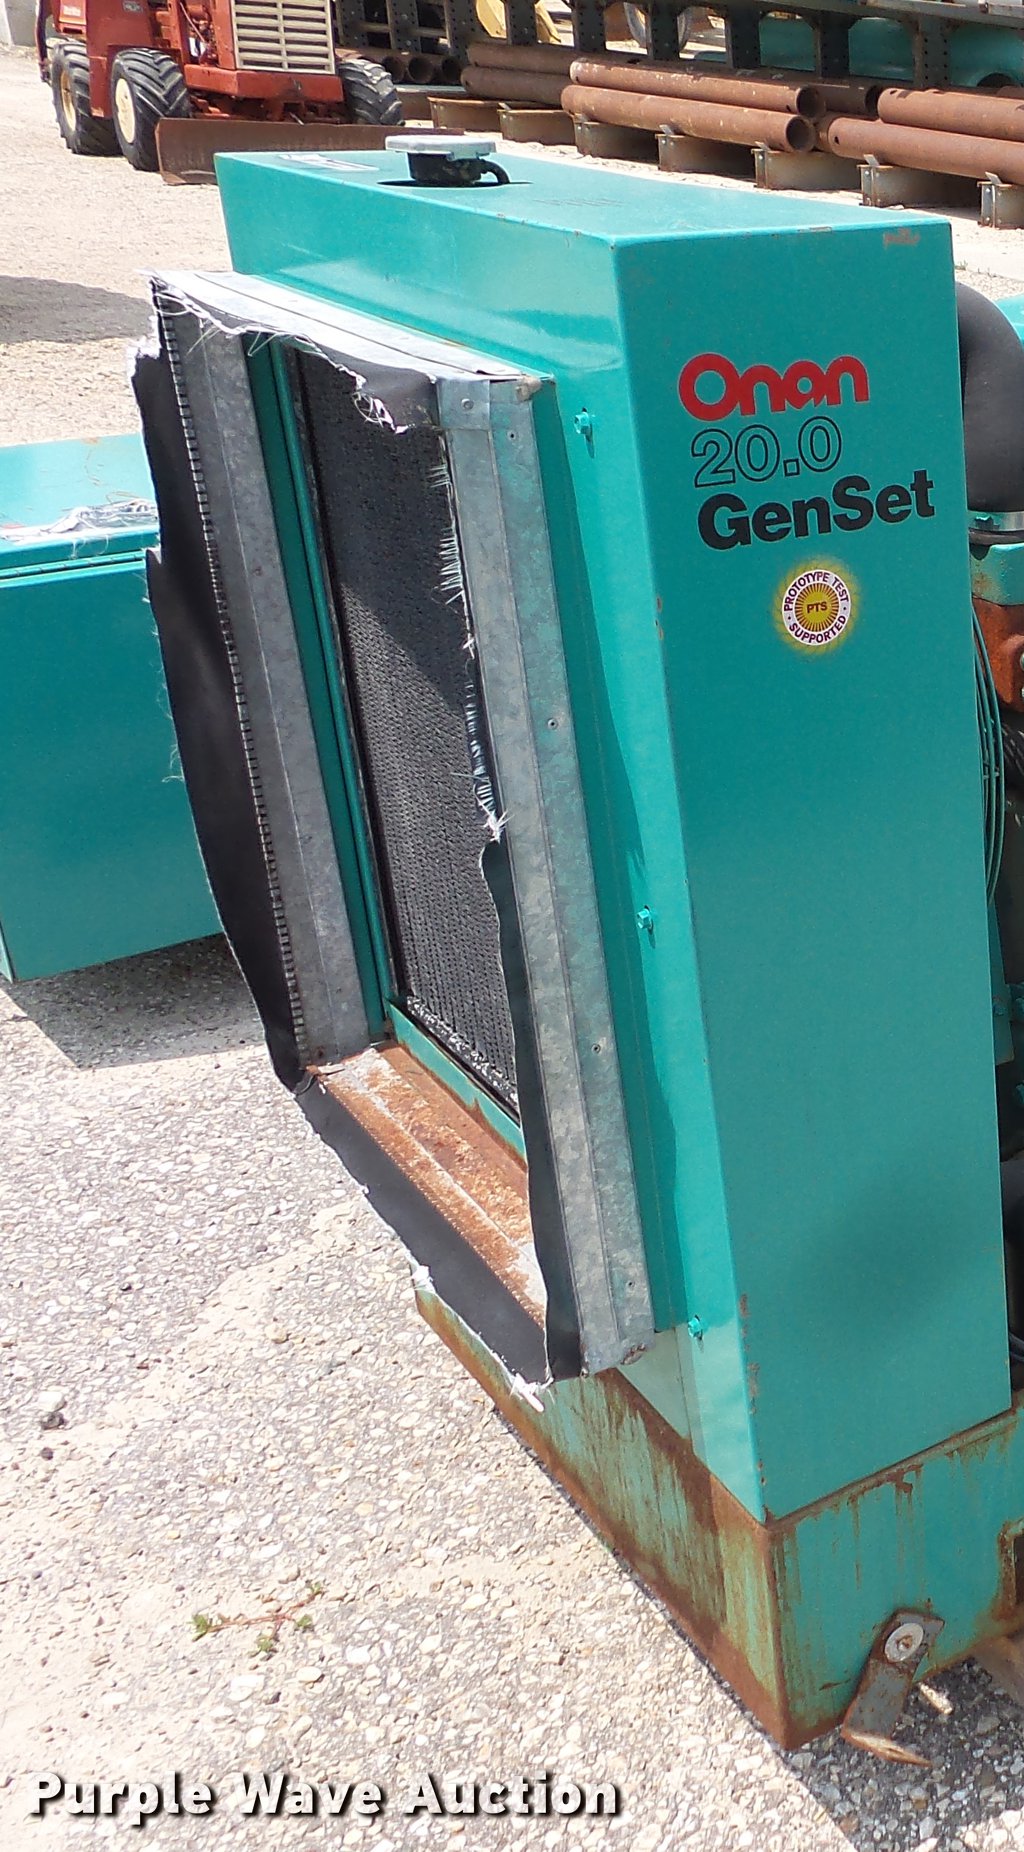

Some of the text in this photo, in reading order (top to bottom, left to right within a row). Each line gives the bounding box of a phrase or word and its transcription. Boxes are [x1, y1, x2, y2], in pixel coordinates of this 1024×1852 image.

[678, 352, 869, 422] Onan
[690, 416, 842, 488] 20.0
[697, 469, 936, 551] GenSet
[784, 571, 849, 612] PROTOTYPE TEST
[806, 601, 828, 614] PTS
[788, 614, 847, 644] SUPPORTED
